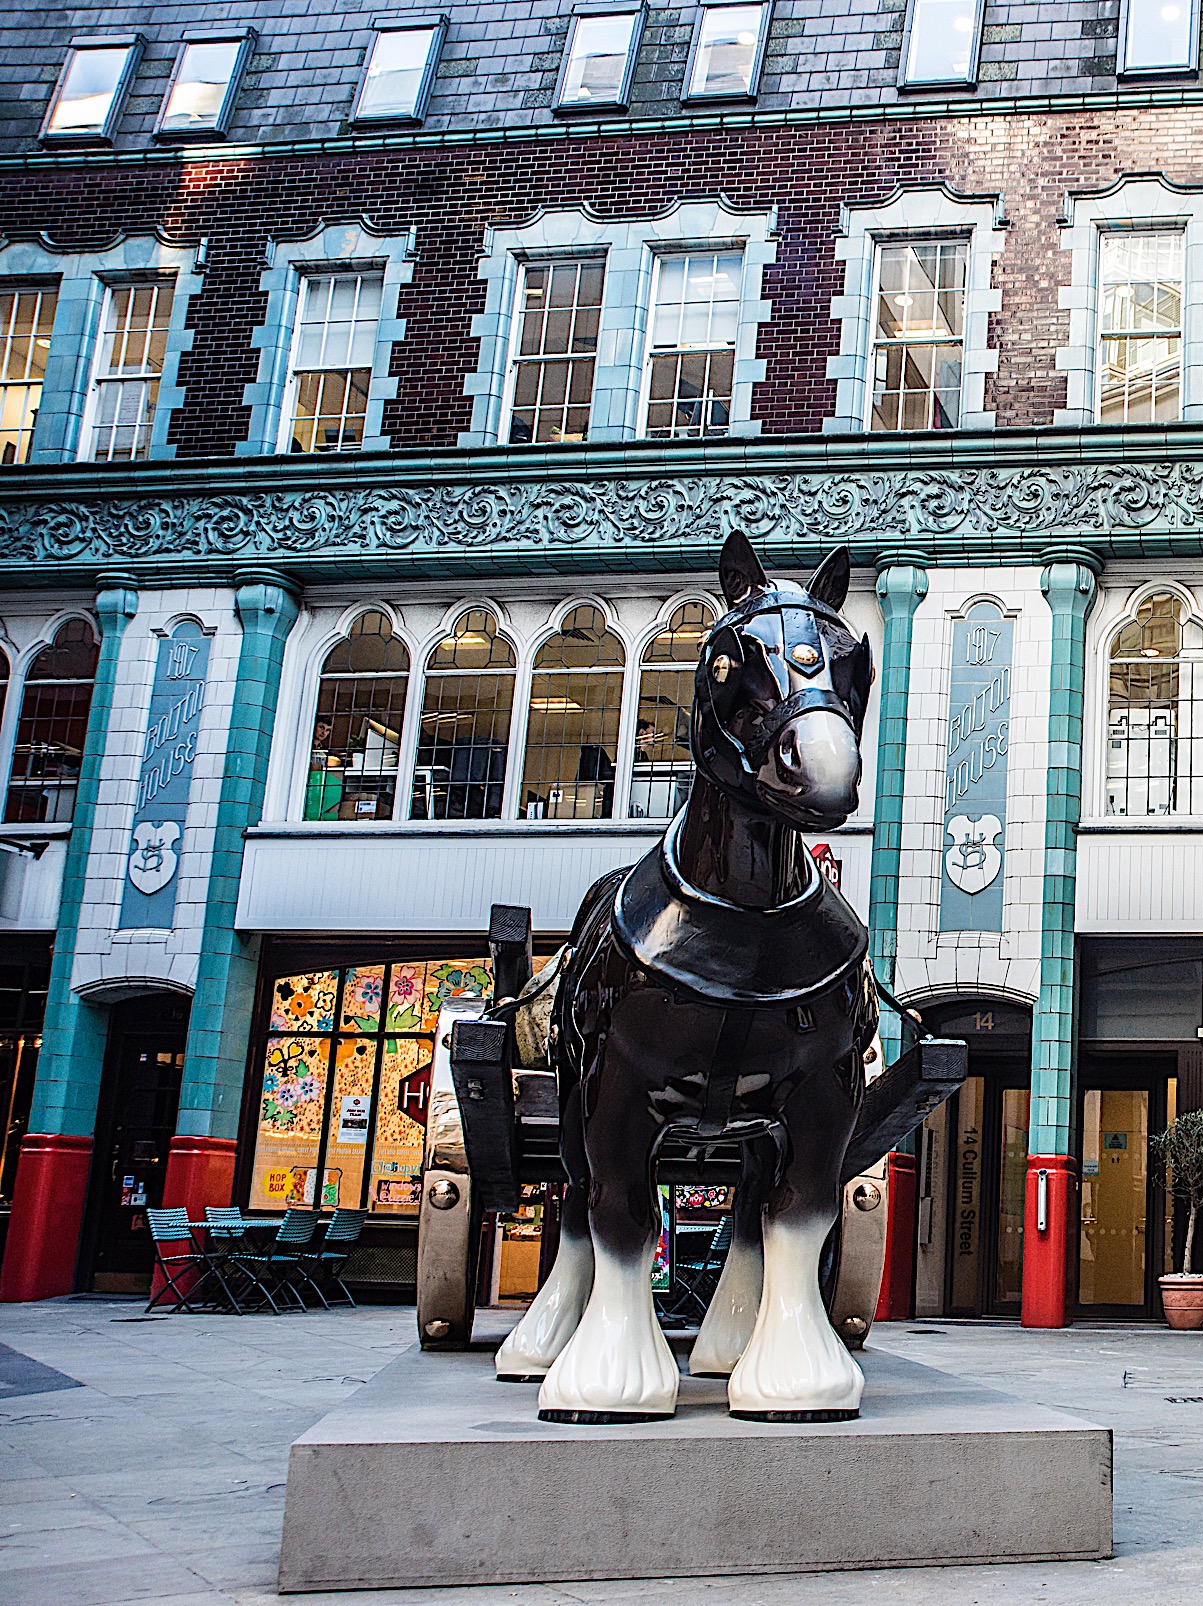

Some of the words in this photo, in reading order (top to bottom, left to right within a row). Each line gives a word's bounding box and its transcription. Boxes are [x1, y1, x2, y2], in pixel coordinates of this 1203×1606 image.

[135, 730, 198, 816] HOUSE
[944, 720, 1009, 813] HOUSE
[974, 1011, 994, 1030] 14
[963, 1127, 979, 1146] 14
[268, 1183, 286, 1193] BOX
[269, 1173, 287, 1183] HOP
[962, 1149, 978, 1205] Cullum
[960, 1209, 976, 1257] Street
